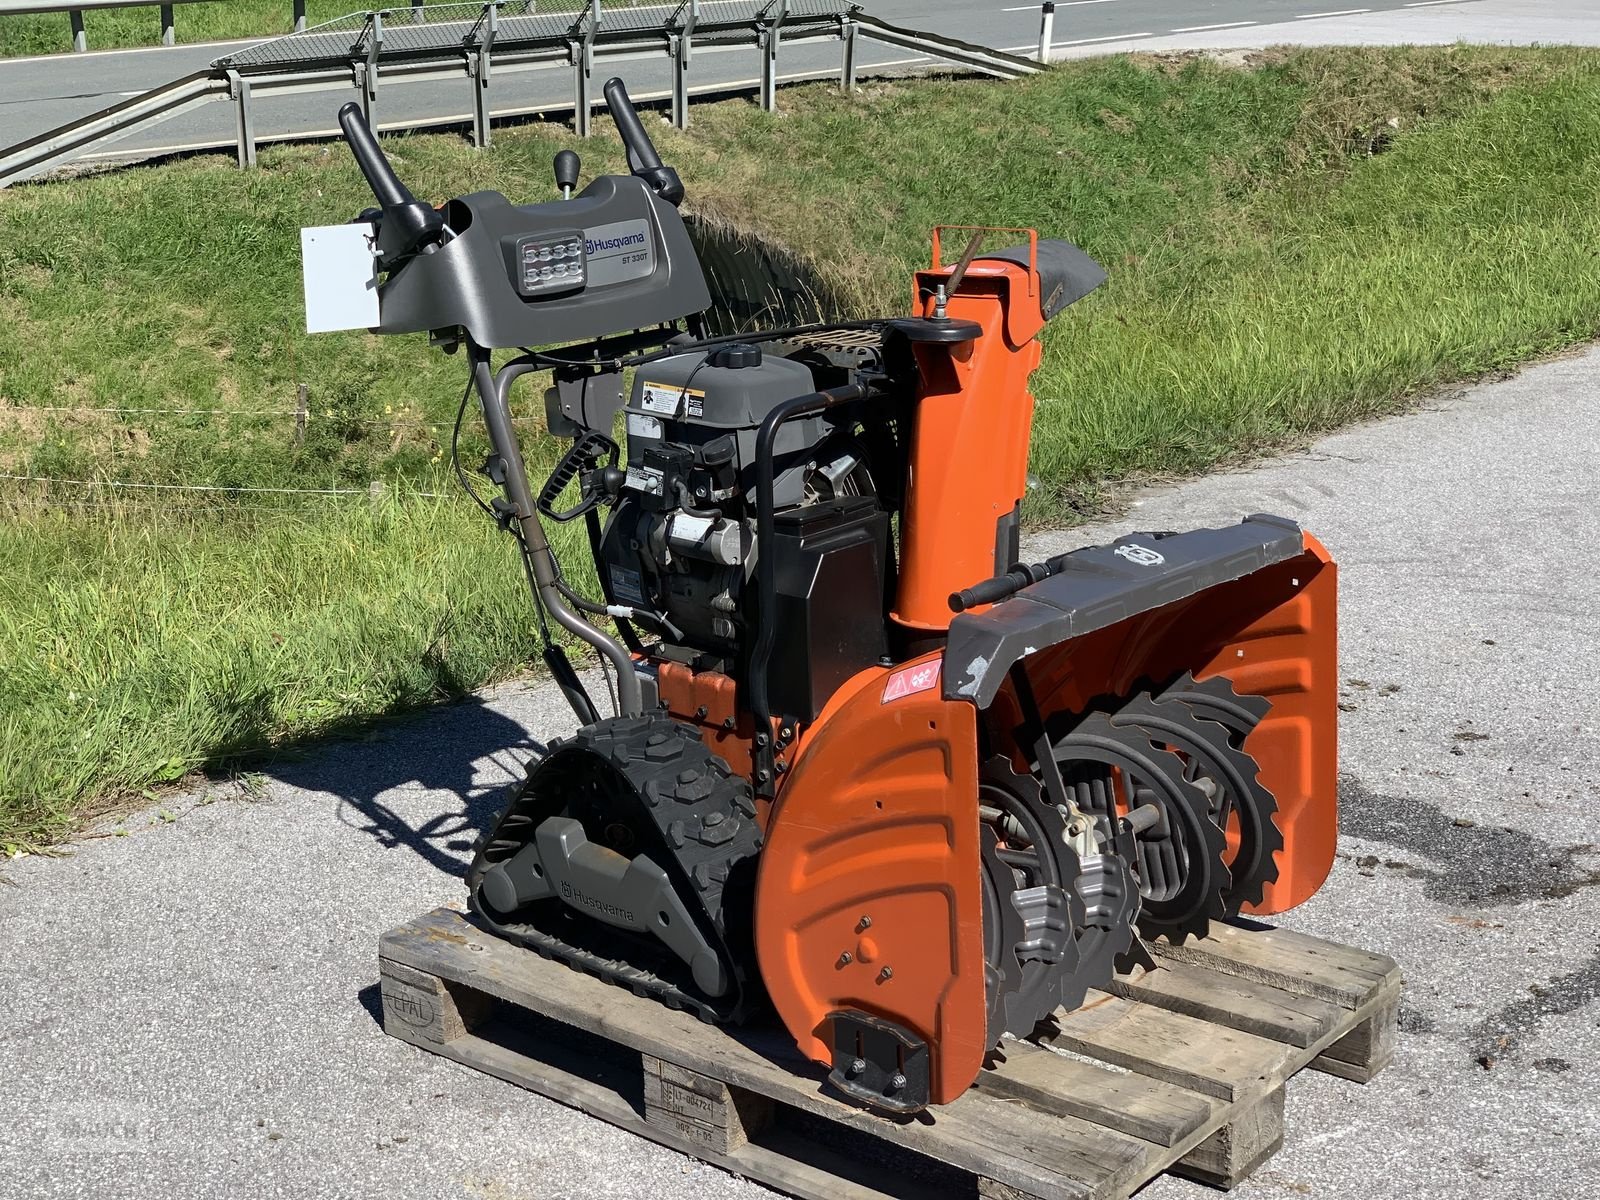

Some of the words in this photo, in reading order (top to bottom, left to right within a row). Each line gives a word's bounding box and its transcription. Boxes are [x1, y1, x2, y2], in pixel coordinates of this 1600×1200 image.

[594, 233, 644, 251] Husqvarna
[622, 256, 631, 264] ST
[632, 253, 647, 263] 330T
[573, 888, 634, 922] Husqvarna
[394, 991, 428, 1020] EPAL
